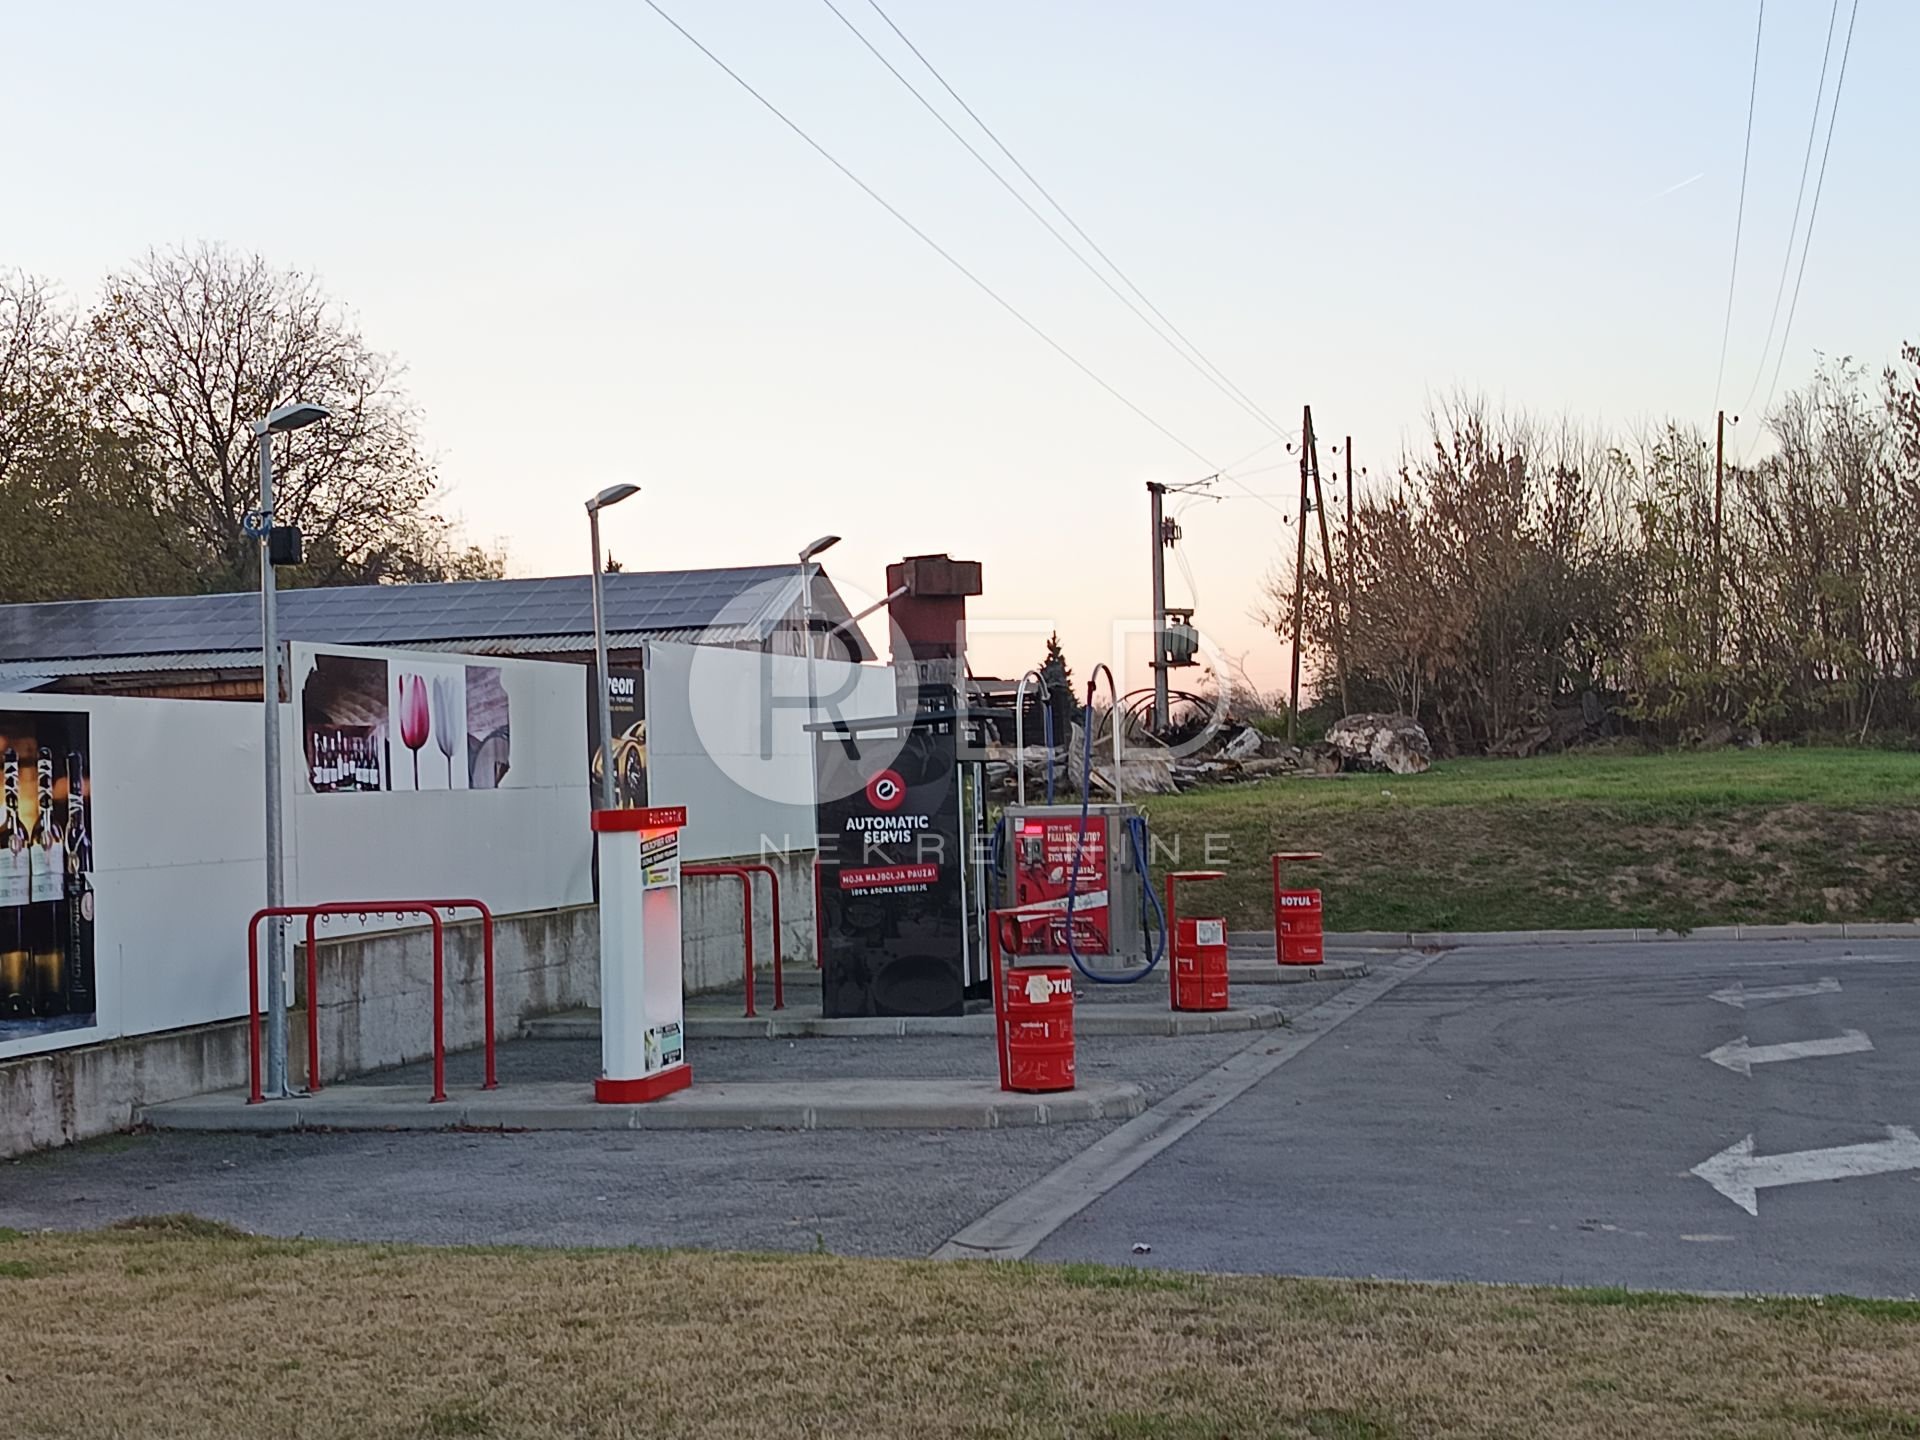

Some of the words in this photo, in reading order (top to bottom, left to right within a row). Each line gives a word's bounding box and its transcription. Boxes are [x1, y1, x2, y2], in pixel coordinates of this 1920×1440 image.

[608, 677, 635, 694] reon
[846, 816, 929, 831] AUTOMATIC
[864, 830, 912, 844] SERVIS
[842, 875, 863, 884] MOJA
[866, 872, 905, 882] NAJBOLJA
[907, 868, 936, 879] PAUZA!
